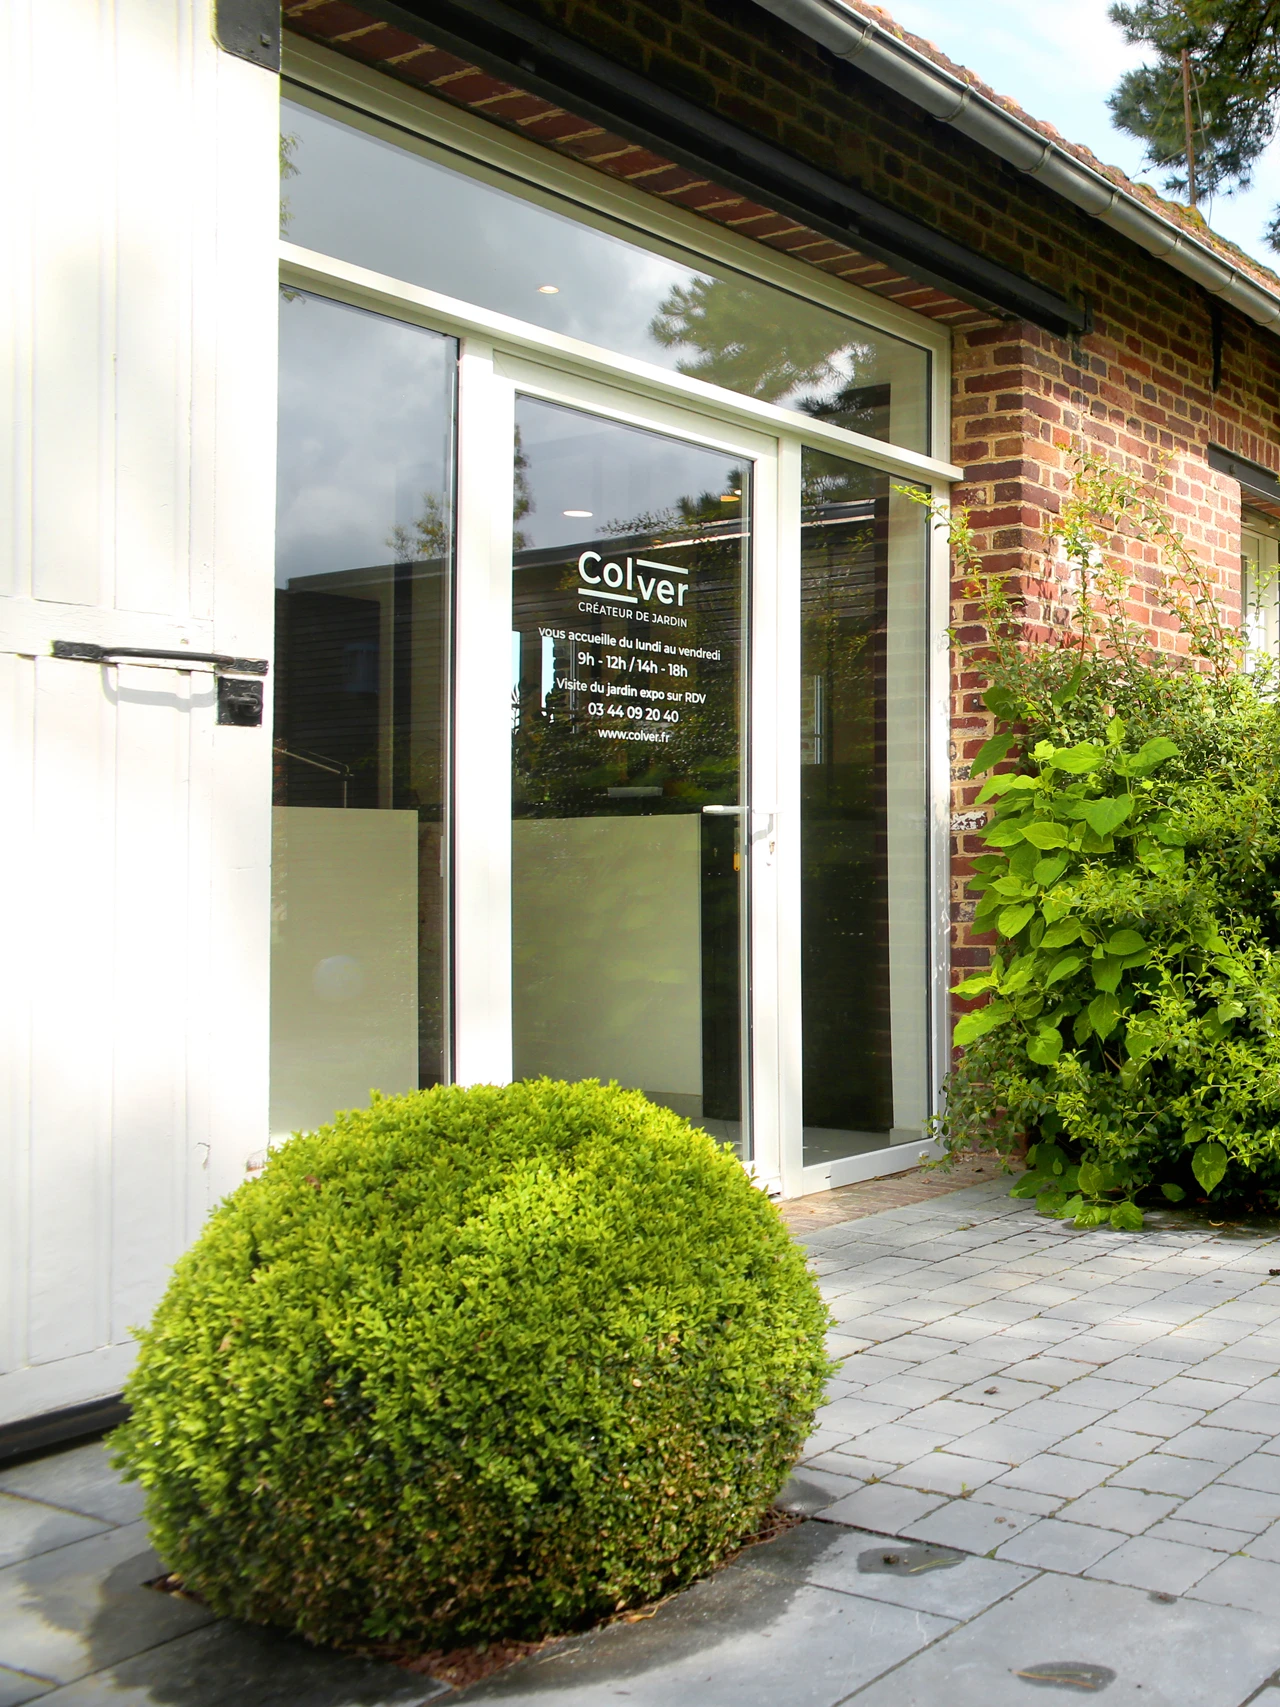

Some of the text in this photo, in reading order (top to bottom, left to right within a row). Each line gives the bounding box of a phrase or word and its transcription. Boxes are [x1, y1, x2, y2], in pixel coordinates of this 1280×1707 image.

[578, 551, 689, 607] Colver
[578, 601, 688, 628] CRÉATEUR DE JARDIN
[538, 626, 721, 661] vous accueille du lundi au vendredi
[577, 651, 595, 667] 9h
[605, 654, 627, 671] 12h
[636, 659, 658, 674] 14h
[668, 663, 688, 678] 18h
[556, 677, 707, 704] Visite du jardin expo sur RDV
[588, 702, 680, 723] 03 44 09 20 40
[598, 728, 670, 743] www.colver.fr
